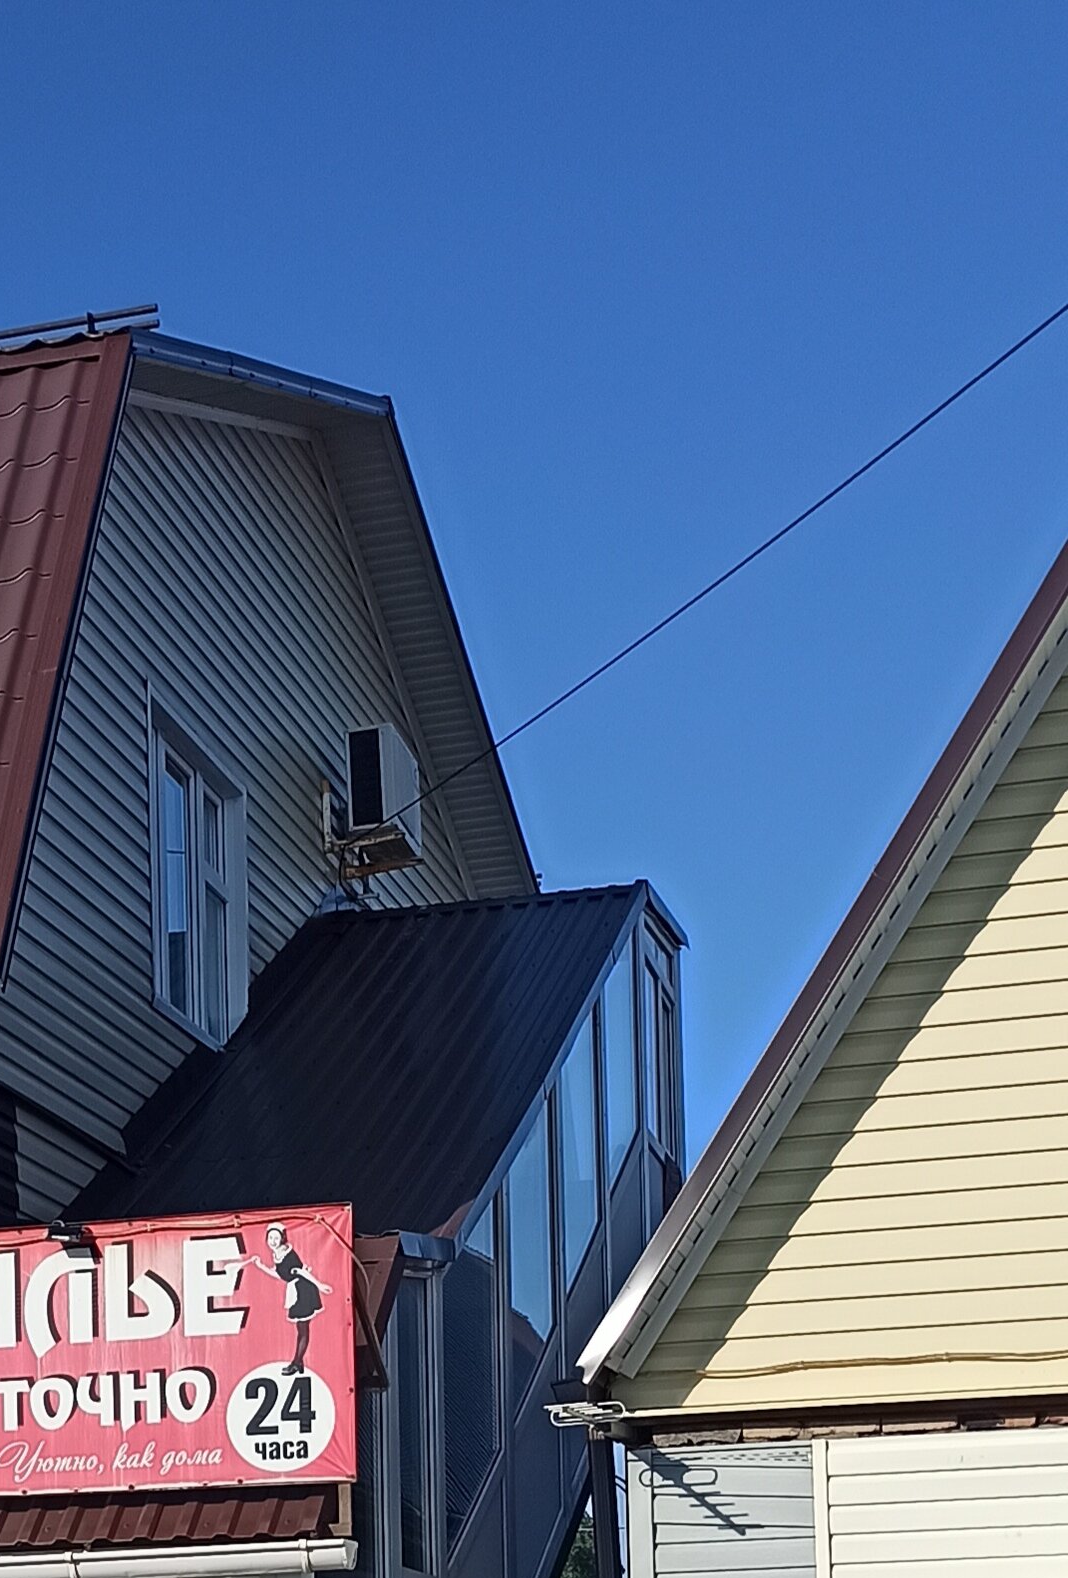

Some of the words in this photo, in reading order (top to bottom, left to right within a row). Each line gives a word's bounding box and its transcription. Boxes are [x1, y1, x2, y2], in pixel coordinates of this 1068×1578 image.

[245, 1377, 316, 1436] 24
[112, 1441, 154, 1470] как
[161, 1447, 222, 1475] дома
[254, 1440, 309, 1461] часа
